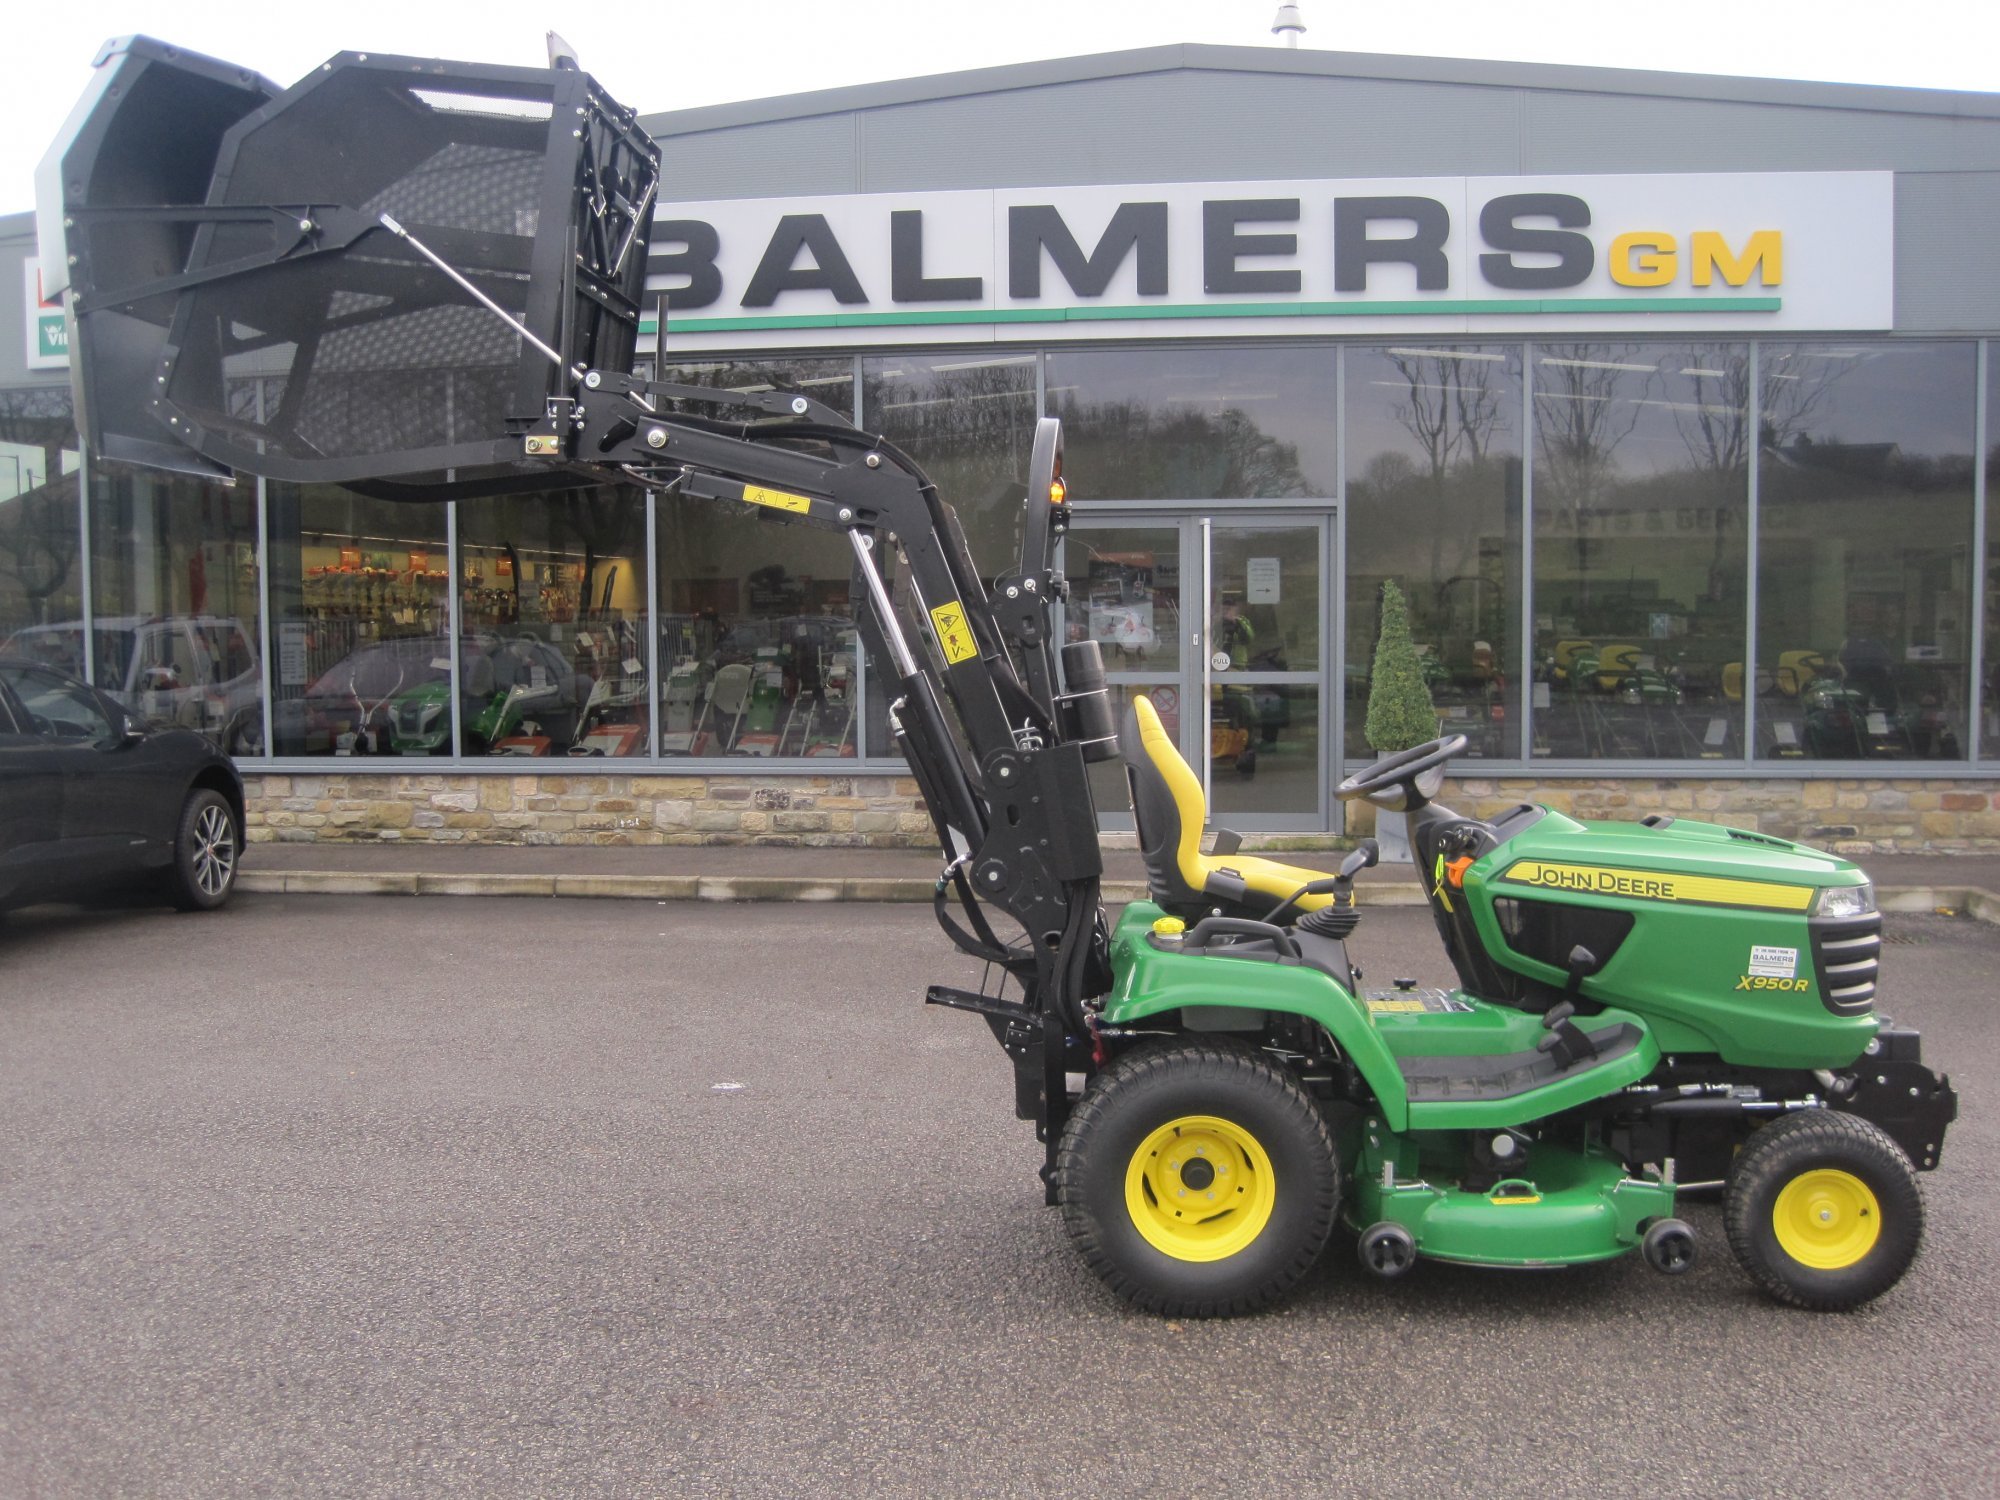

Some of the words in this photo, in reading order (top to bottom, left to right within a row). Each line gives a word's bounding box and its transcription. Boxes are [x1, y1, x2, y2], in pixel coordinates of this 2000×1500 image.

[640, 193, 1595, 311] BALMERS
[1609, 230, 1782, 288] GM
[1529, 865, 1592, 888] JOHN
[1598, 871, 1675, 898] DEERE
[1753, 954, 1794, 963] BALMERS
[1735, 975, 1809, 992] X950R
